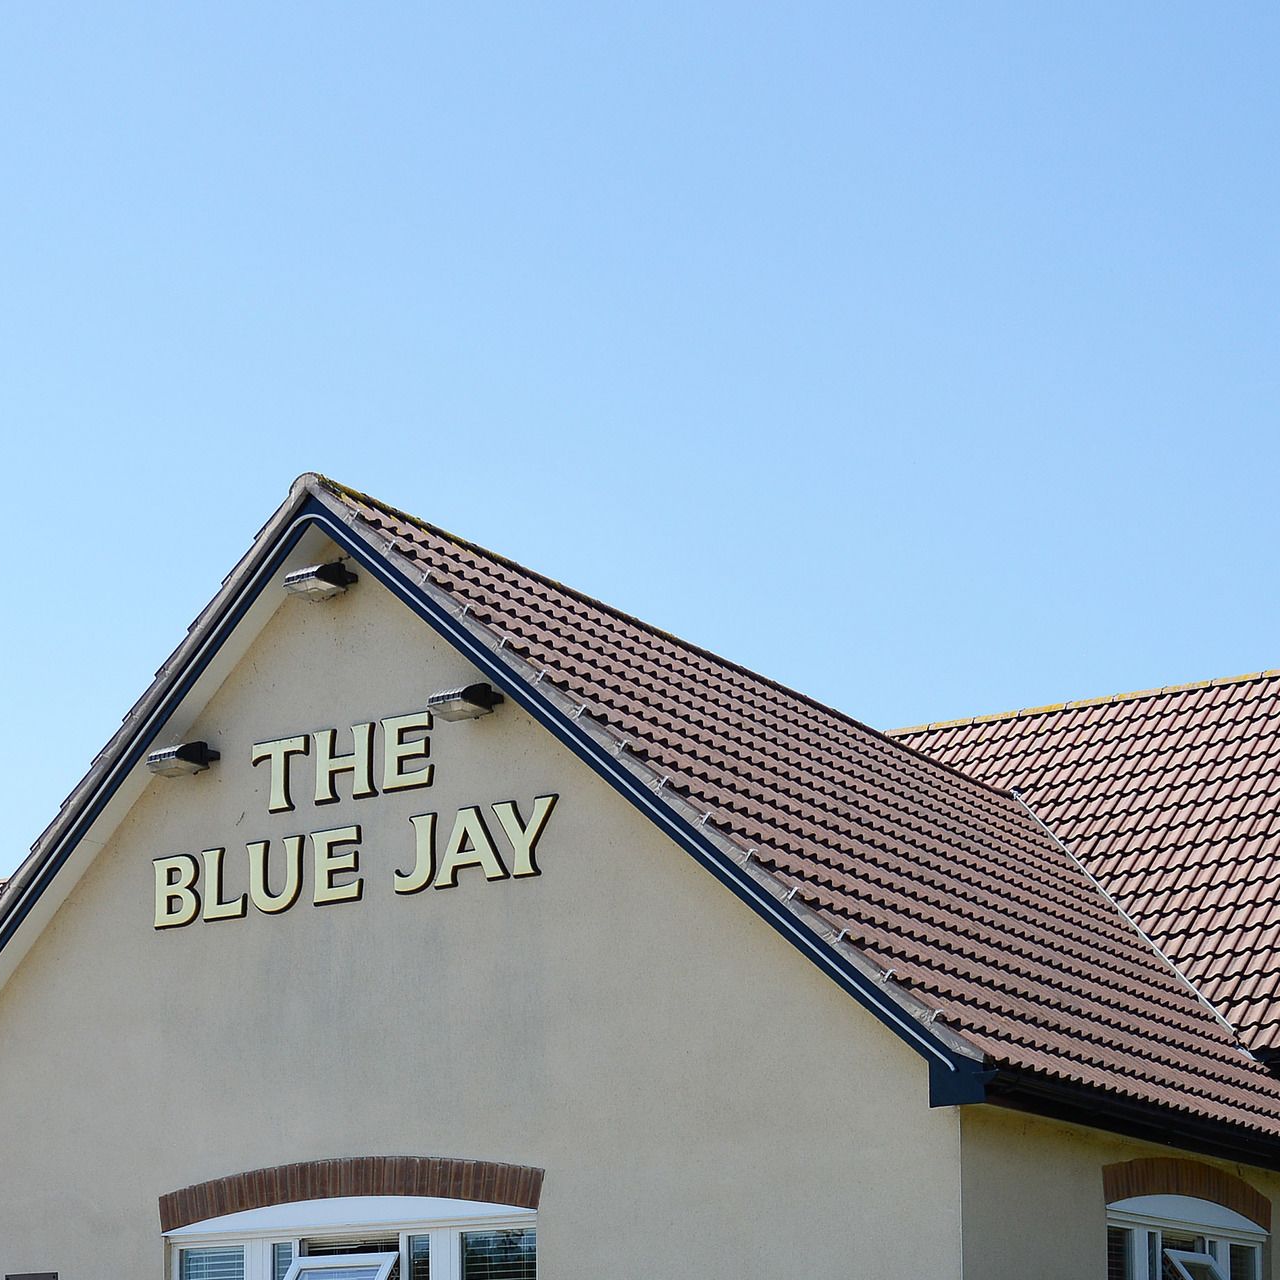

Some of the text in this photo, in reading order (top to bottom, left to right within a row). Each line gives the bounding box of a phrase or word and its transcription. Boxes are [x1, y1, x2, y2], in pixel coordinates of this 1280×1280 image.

[251, 710, 435, 815] THE
[152, 793, 560, 930] BLUE JAY
